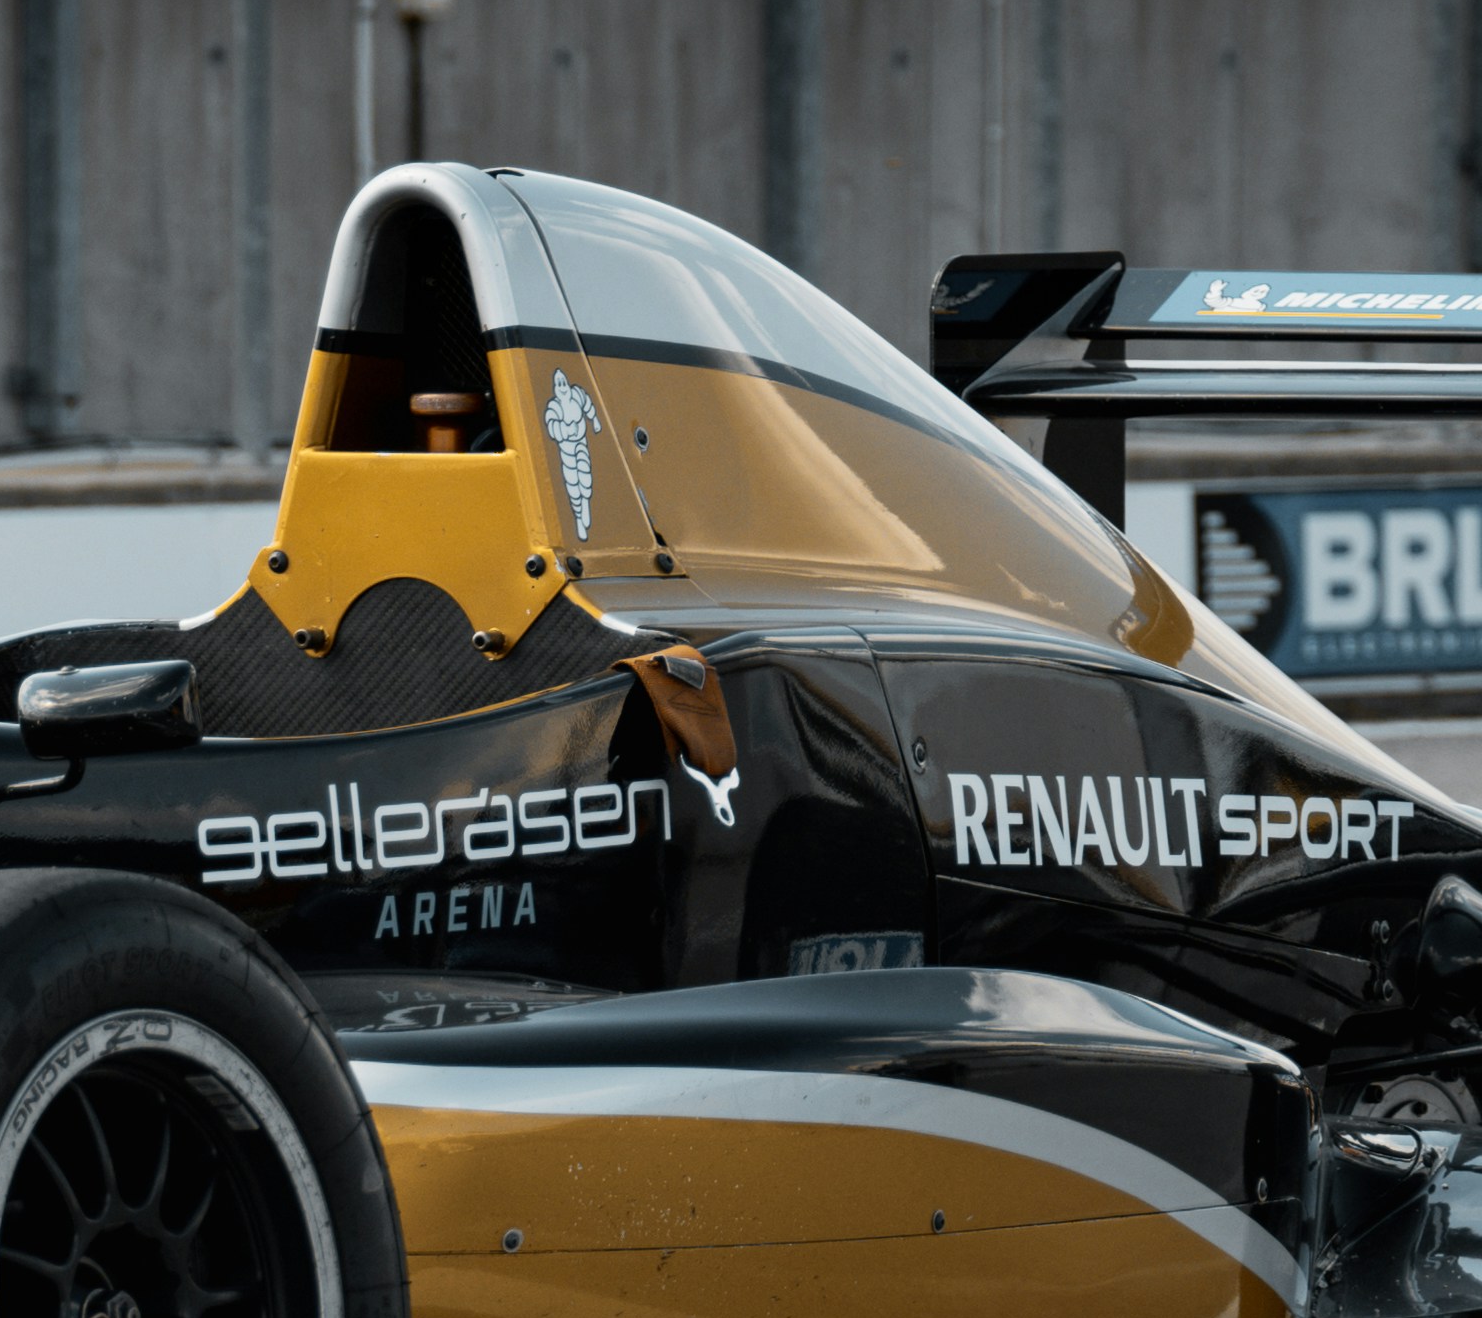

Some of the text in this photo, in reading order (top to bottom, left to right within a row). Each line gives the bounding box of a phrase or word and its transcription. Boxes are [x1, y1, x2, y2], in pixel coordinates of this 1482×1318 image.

[947, 773, 1414, 868] RENAULT SPORT
[374, 882, 536, 939] ARENA
[13, 1033, 91, 1133] RACING
